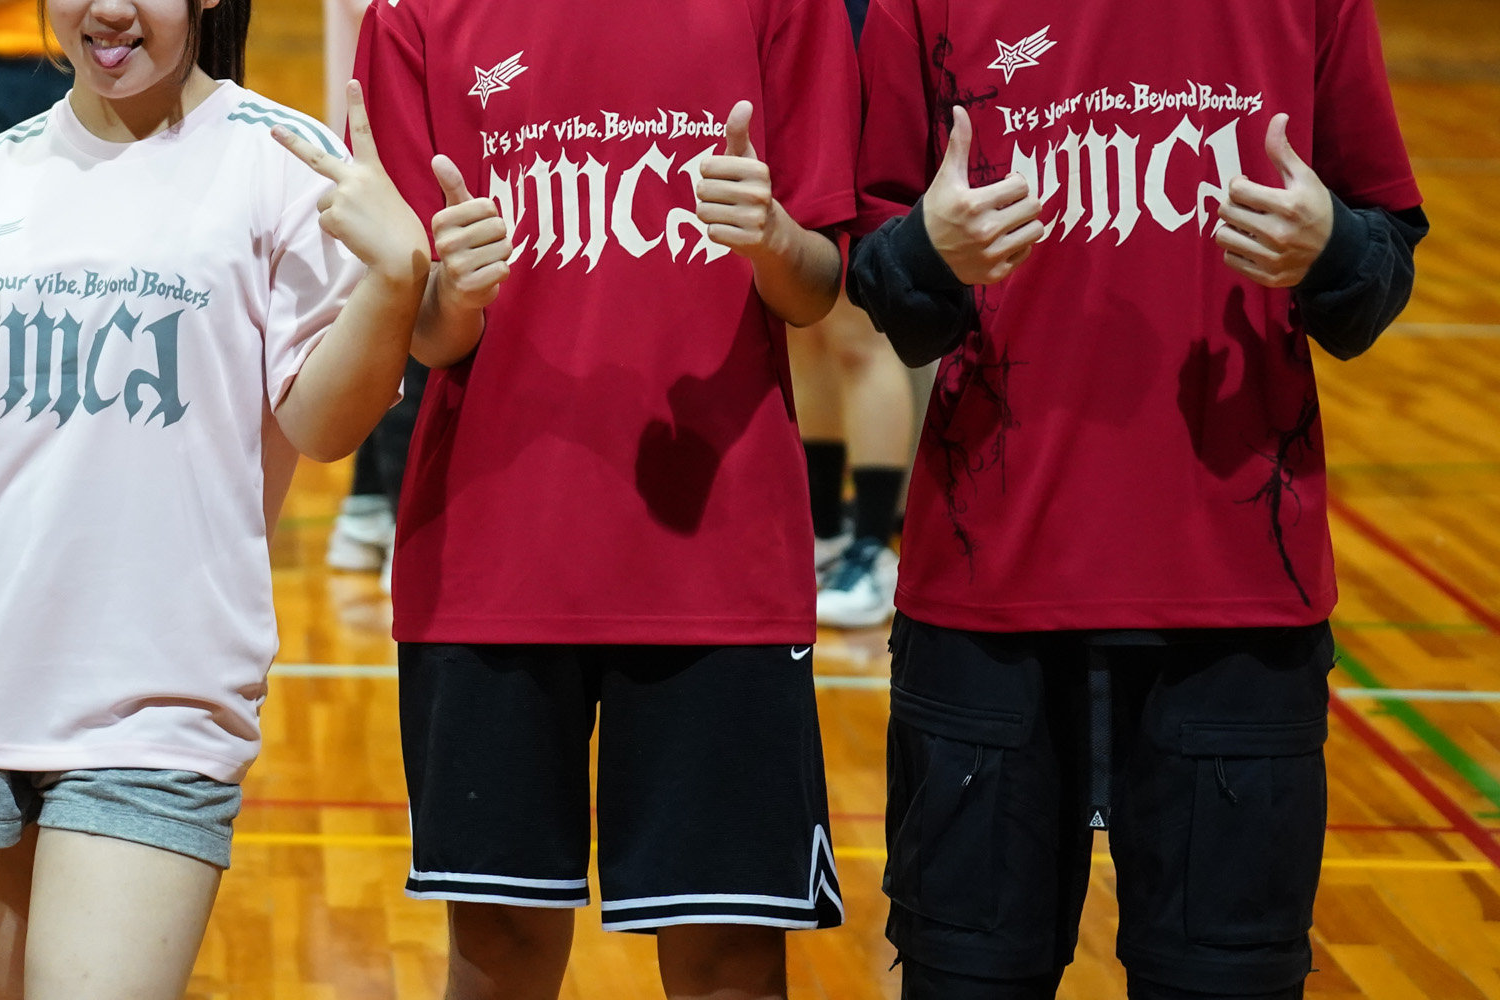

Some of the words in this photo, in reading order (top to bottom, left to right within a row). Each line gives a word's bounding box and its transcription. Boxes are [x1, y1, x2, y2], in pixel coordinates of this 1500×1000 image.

[480, 131, 511, 159] It's
[514, 120, 551, 152] yur
[553, 115, 602, 142] vibe.
[600, 107, 667, 142] Beyond
[668, 109, 726, 140] Borde
[996, 106, 1039, 135] It's
[1042, 93, 1083, 128] your
[1085, 87, 1131, 114] vibe.
[1129, 80, 1197, 114] Beyond
[1197, 83, 1263, 115] Borders
[35, 272, 81, 297] vibe.
[80, 266, 138, 300] Beyond
[137, 268, 211, 310] Borders
